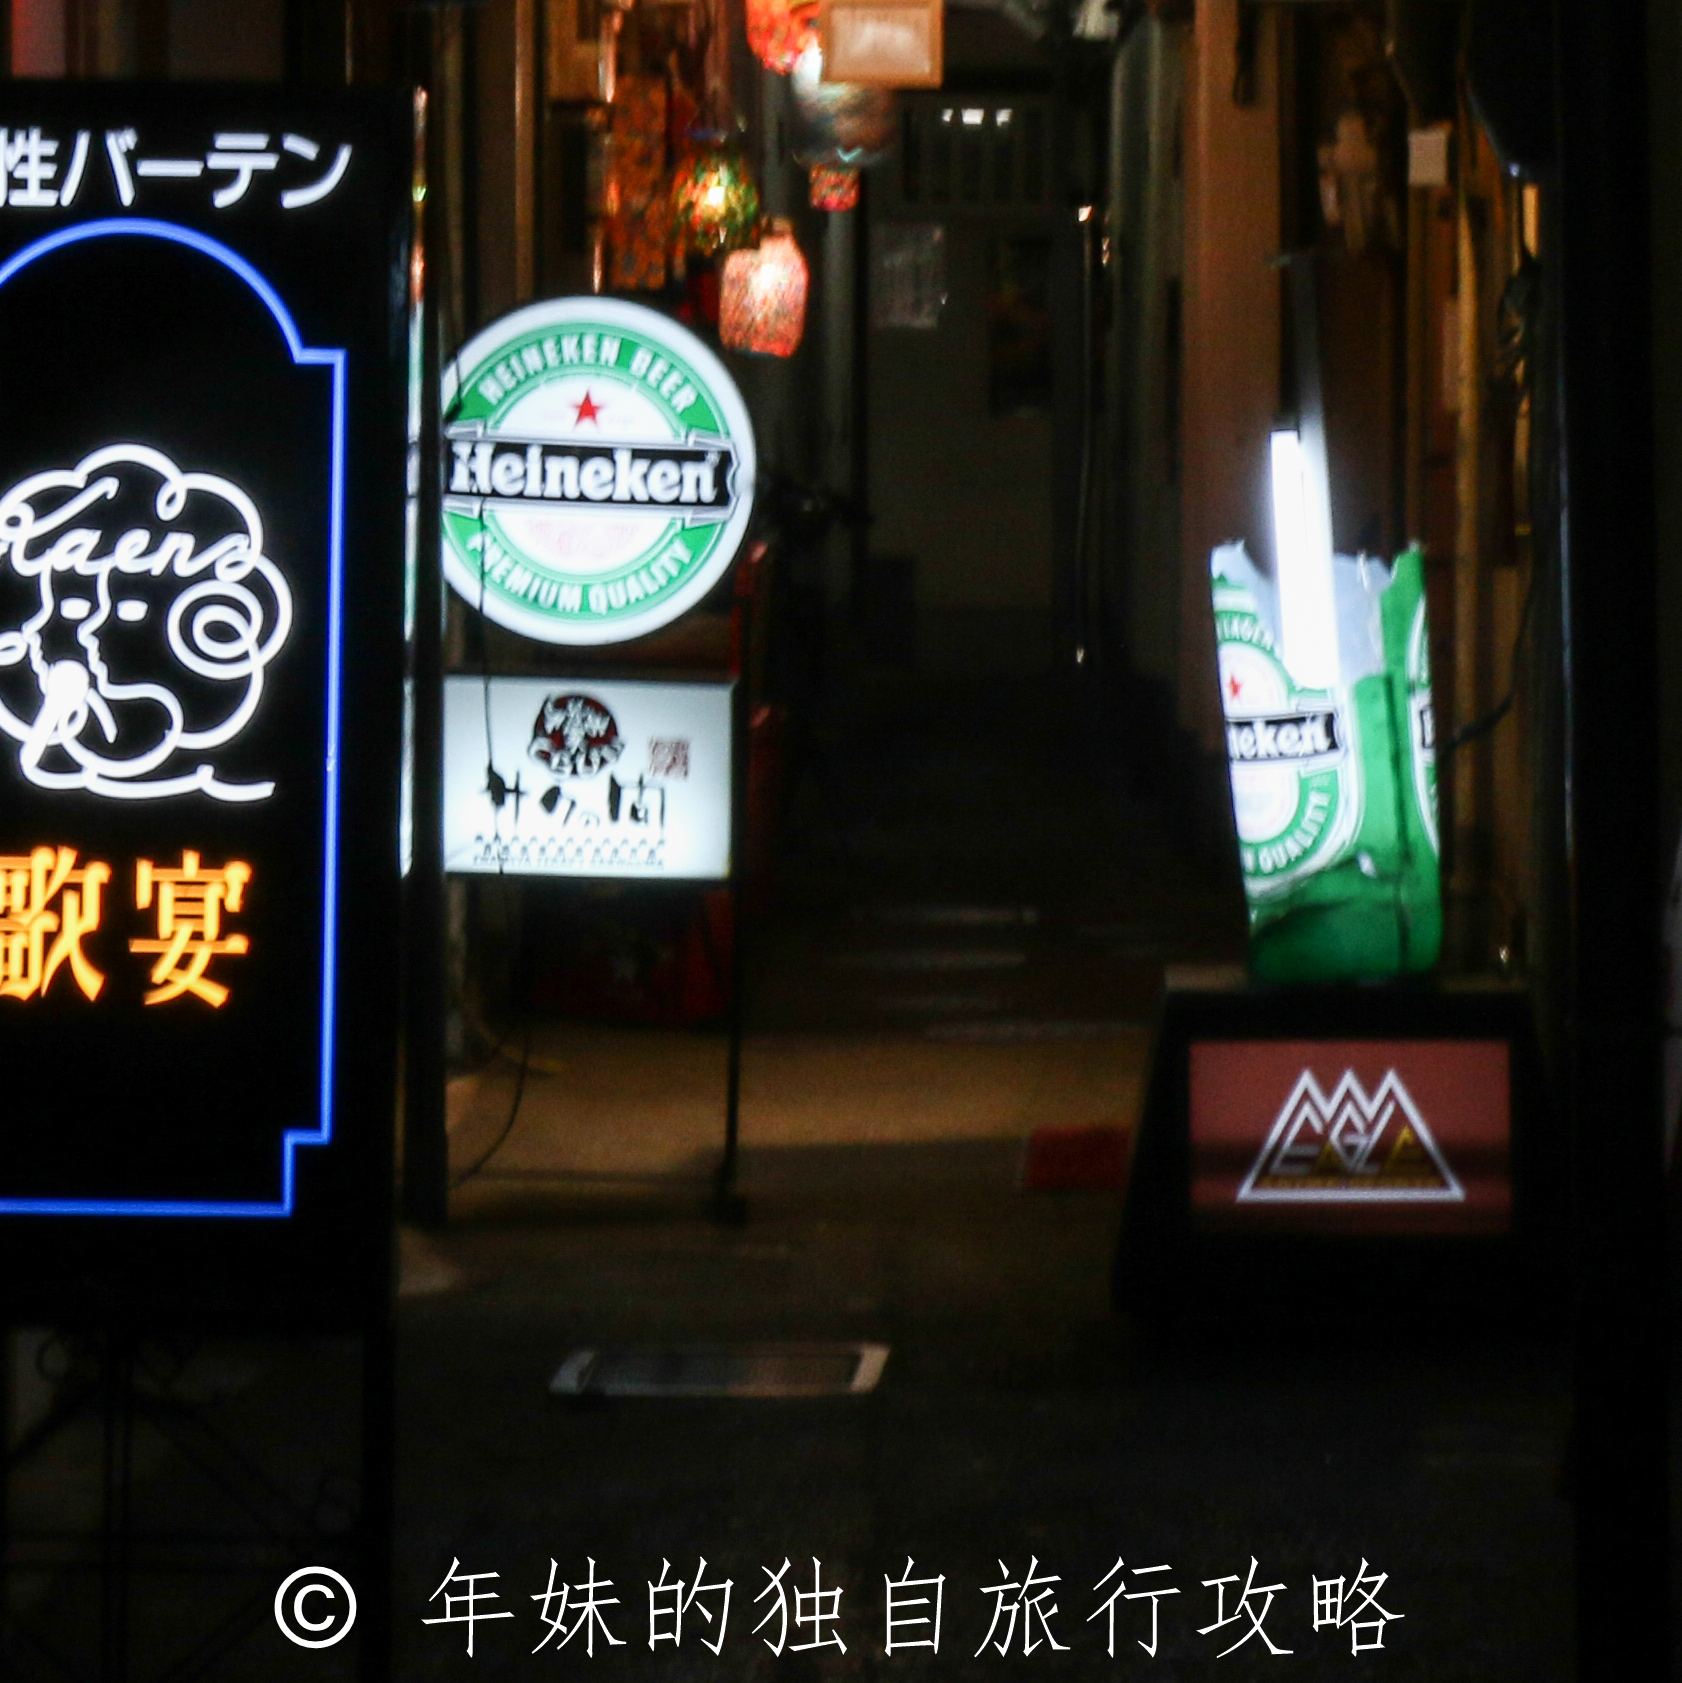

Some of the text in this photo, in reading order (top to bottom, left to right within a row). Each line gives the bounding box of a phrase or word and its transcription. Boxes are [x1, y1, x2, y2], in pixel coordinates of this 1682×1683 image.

[477, 335, 698, 414] HEINEKEN BEER
[449, 441, 717, 503] Heineken
[469, 531, 693, 615] PREMIUM QUALITY
